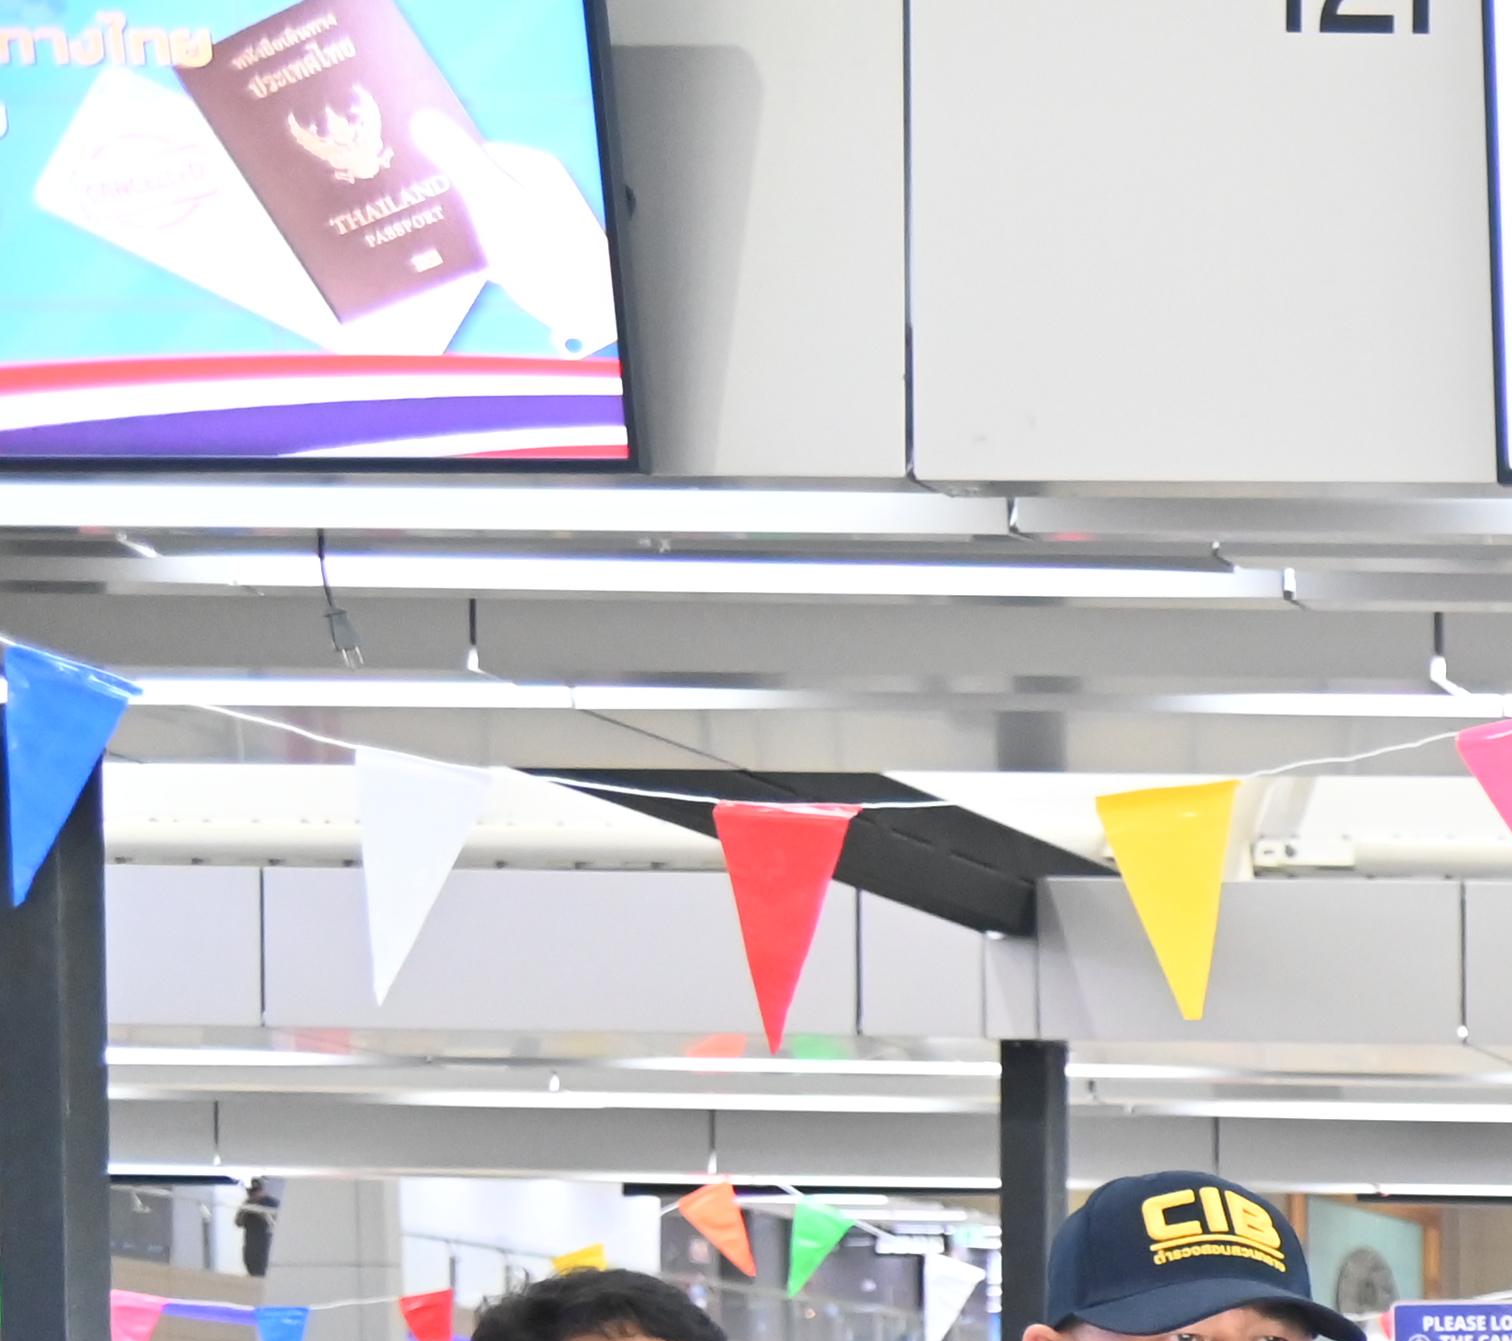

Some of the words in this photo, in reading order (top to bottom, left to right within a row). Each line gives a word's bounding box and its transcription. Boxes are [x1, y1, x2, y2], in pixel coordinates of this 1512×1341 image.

[329, 175, 452, 236] THAILAND
[364, 205, 446, 248] PASSPORT
[1142, 1186, 1281, 1249] CIB
[1422, 1315, 1487, 1332] PLEASE
